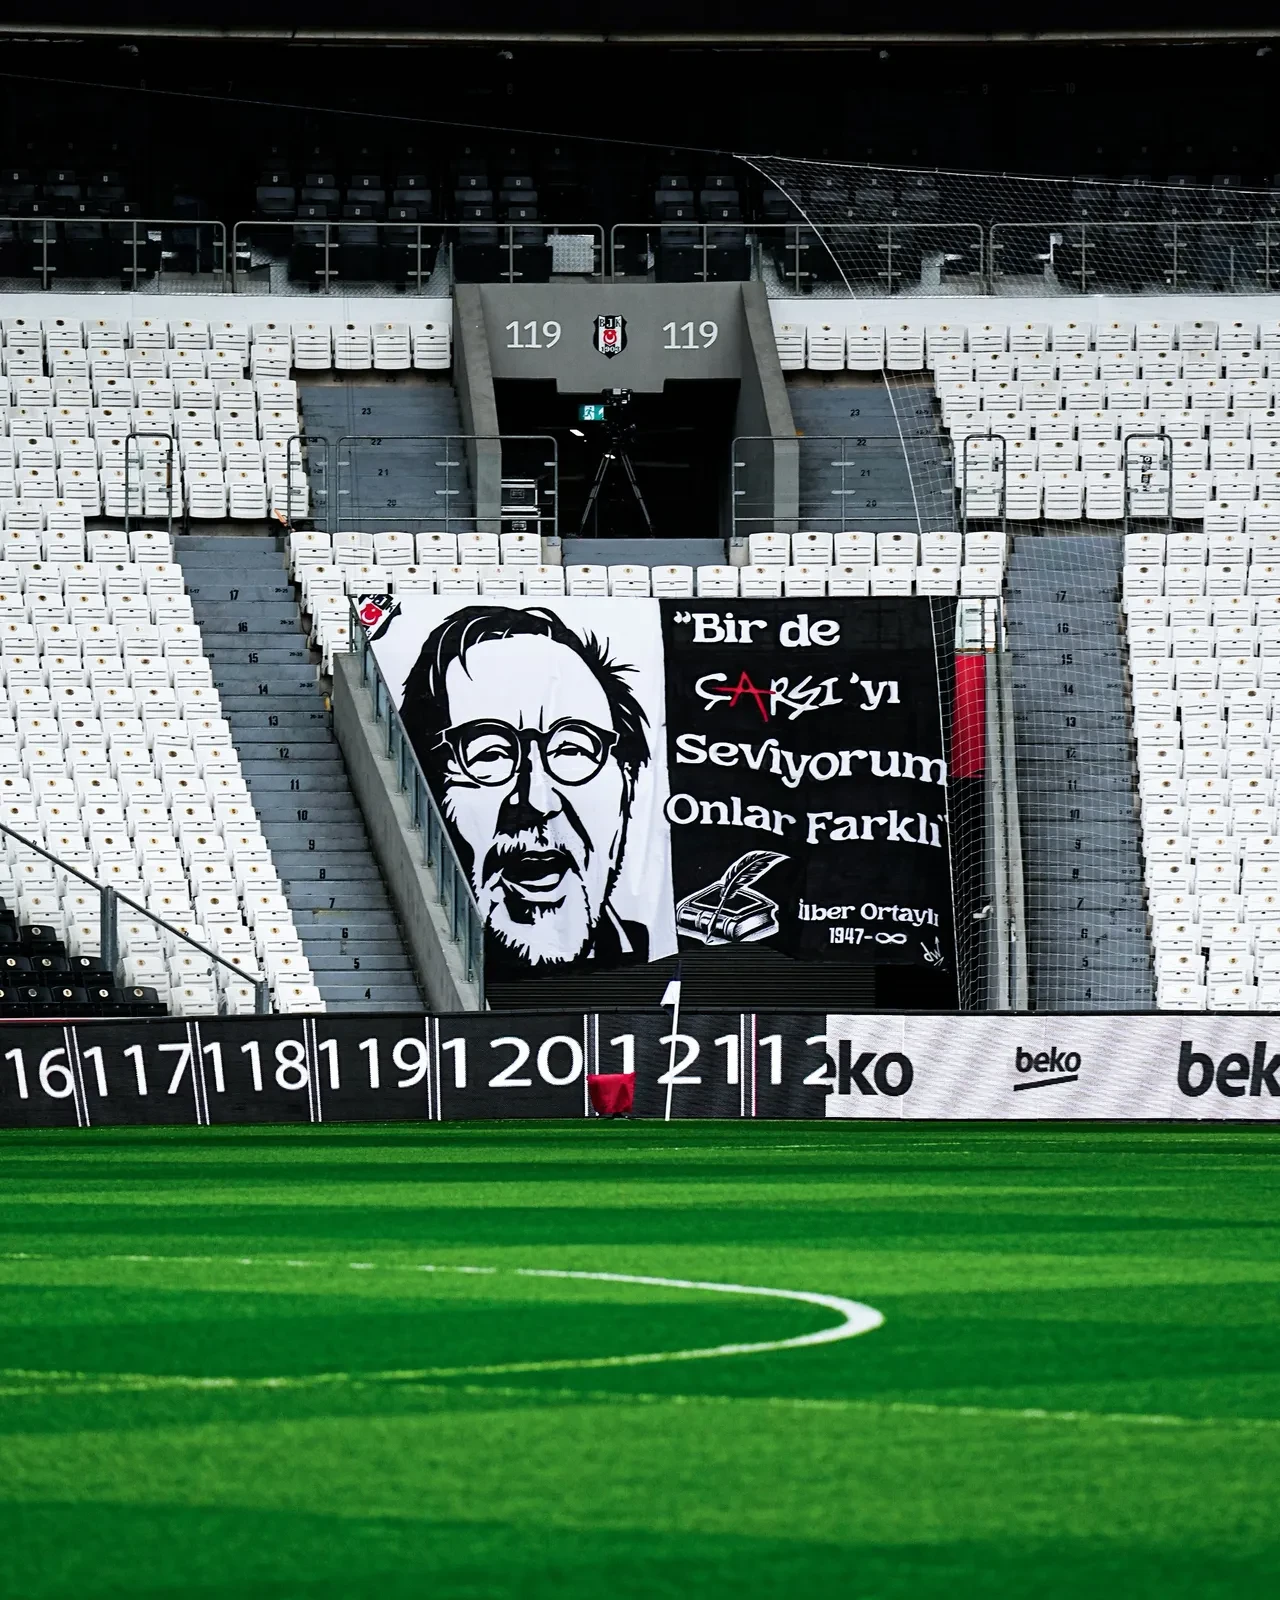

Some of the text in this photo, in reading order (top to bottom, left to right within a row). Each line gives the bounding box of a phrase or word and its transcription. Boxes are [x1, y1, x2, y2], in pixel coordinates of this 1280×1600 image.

[600, 318, 622, 328] BJK
[505, 320, 562, 348] 119
[662, 320, 718, 349] 119
[850, 408, 860, 416] 23
[371, 438, 382, 446] 22
[856, 438, 866, 446] 22
[378, 468, 389, 476] 21
[866, 500, 877, 508] 20
[230, 590, 239, 600] 17
[1056, 590, 1067, 601] 17
[238, 621, 248, 632] 16
[780, 614, 840, 647] de
[1057, 623, 1069, 633] 16
[248, 652, 258, 664] 15
[1062, 654, 1072, 664] 15
[258, 684, 268, 694] 14
[1064, 684, 1074, 695] 14
[268, 716, 278, 726] 13
[1066, 717, 1076, 727] 13
[278, 748, 290, 758] 12
[1066, 748, 1076, 758] 12
[676, 734, 948, 788] Seviyorum
[290, 778, 300, 790] 11
[1068, 780, 1077, 790] 11
[297, 810, 308, 821] 10
[666, 794, 796, 836] Onlar
[1070, 810, 1080, 820] 10
[308, 840, 315, 850] 9
[1075, 839, 1082, 850] 9
[320, 868, 326, 879] 8
[1072, 868, 1079, 878] 8
[329, 898, 336, 908] 7
[1076, 898, 1084, 908] 7
[860, 902, 939, 926] Ortaylı
[342, 928, 348, 938] 6
[1080, 928, 1088, 939] 6
[354, 958, 360, 969] 5
[1082, 956, 1088, 967] 5
[365, 988, 371, 999] 4
[1085, 988, 1092, 998] 4
[1015, 1046, 1082, 1073] beko
[83, 1042, 193, 1097] 117
[203, 1040, 309, 1092] 118
[318, 1038, 428, 1089] 119
[442, 1036, 584, 1088] 120
[610, 1034, 738, 1084] 121
